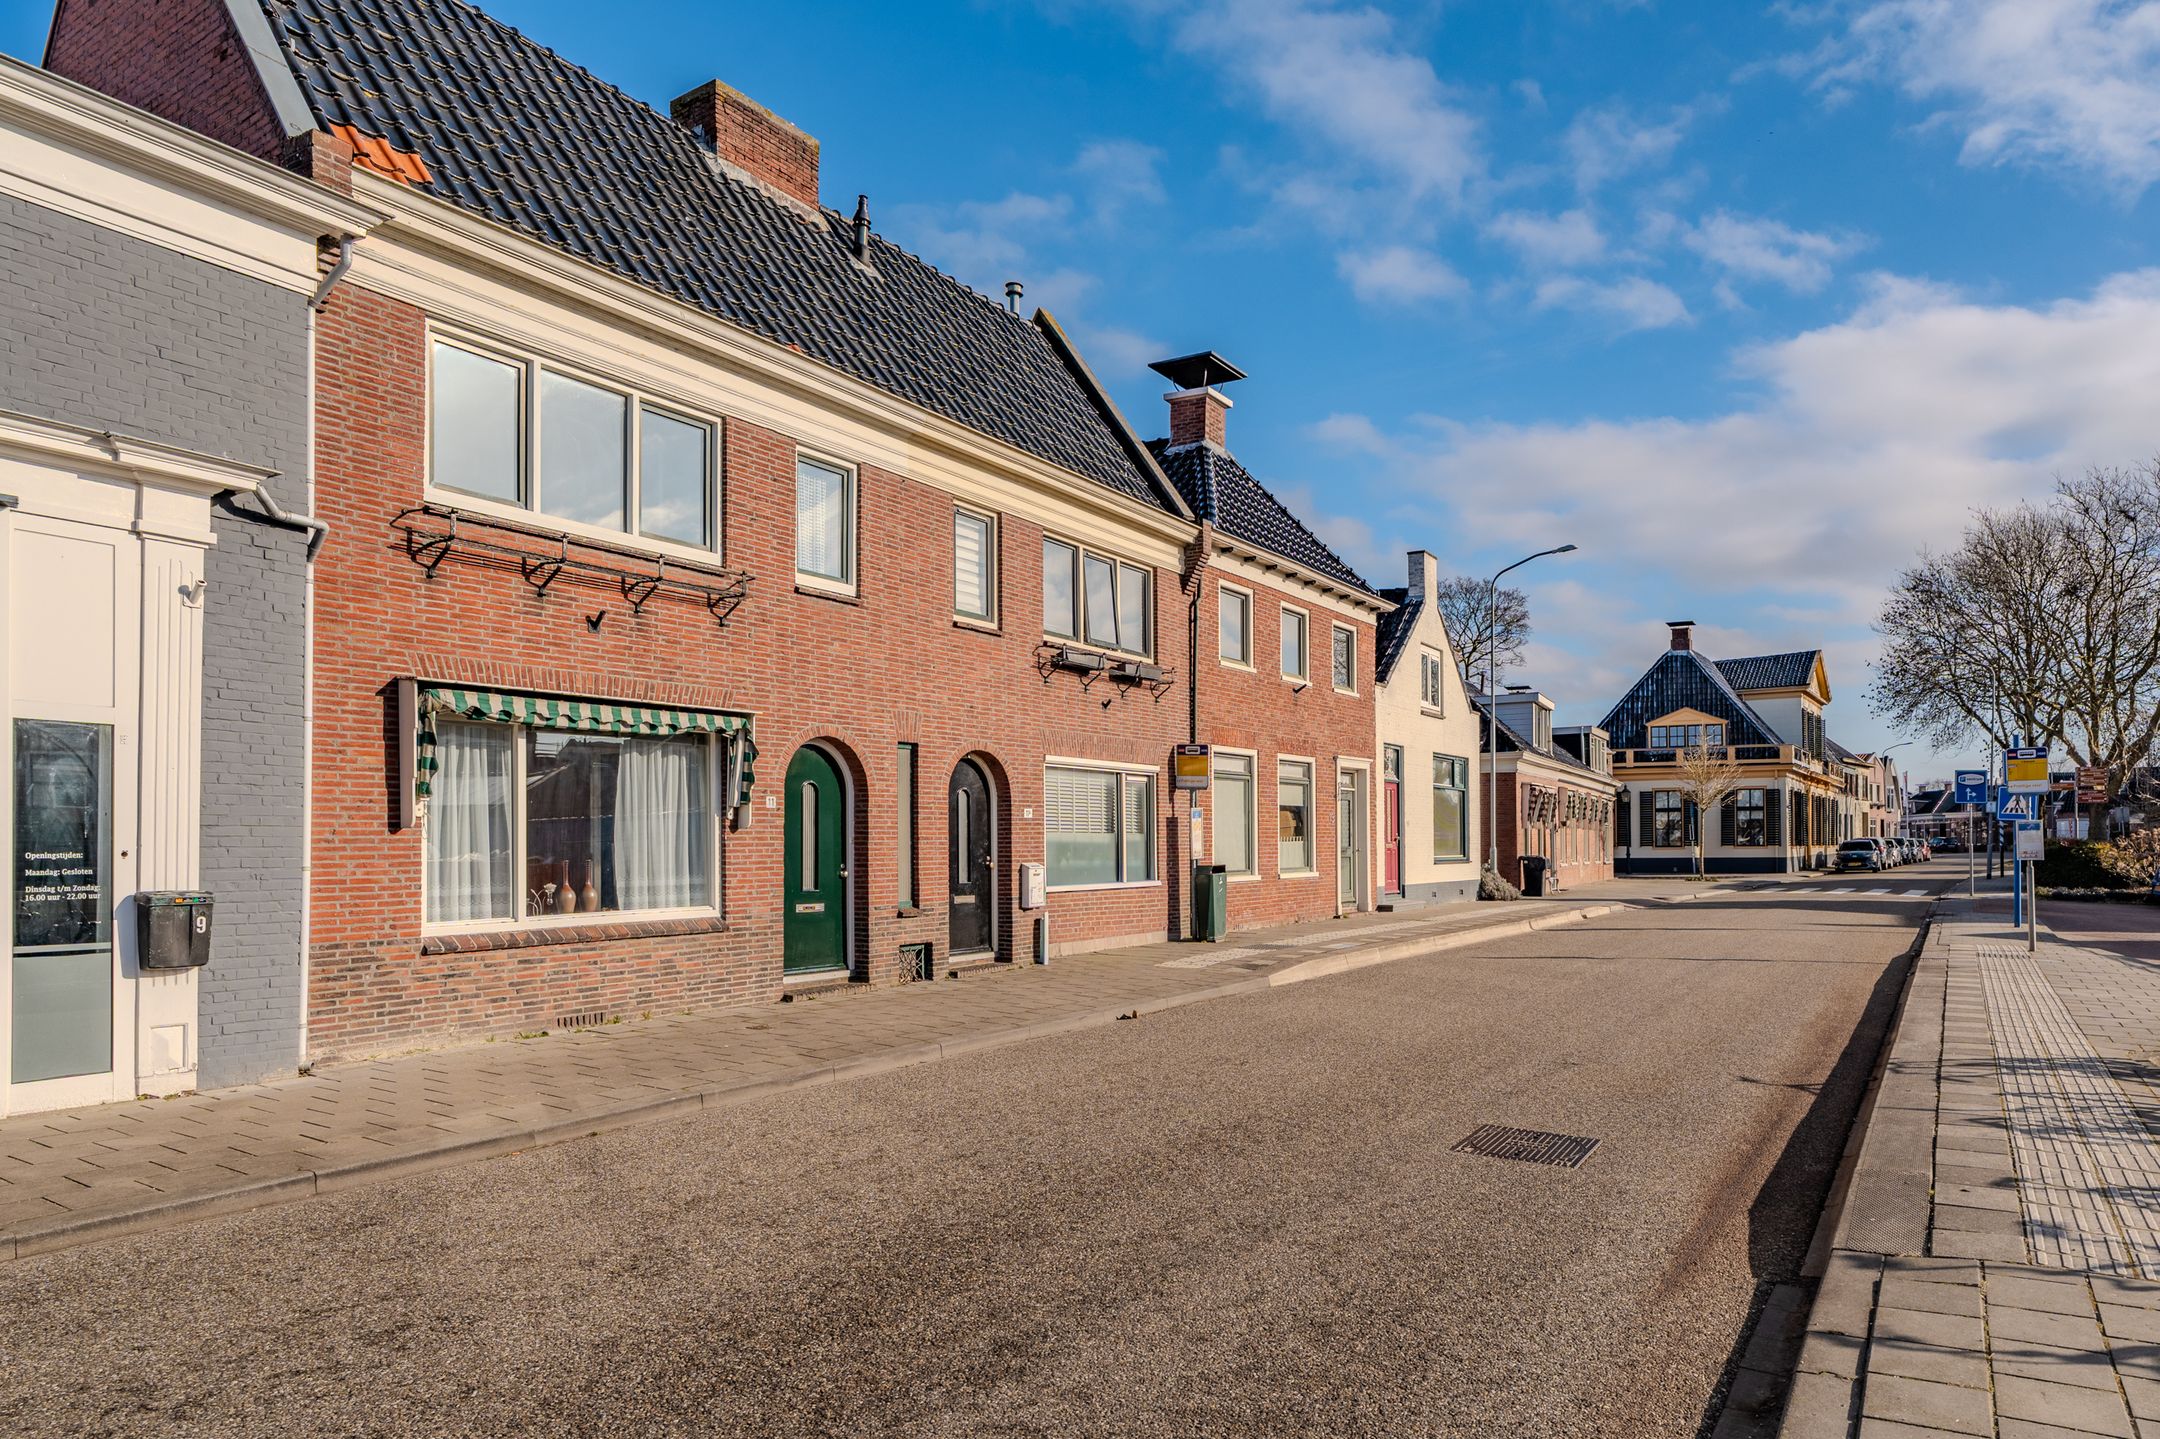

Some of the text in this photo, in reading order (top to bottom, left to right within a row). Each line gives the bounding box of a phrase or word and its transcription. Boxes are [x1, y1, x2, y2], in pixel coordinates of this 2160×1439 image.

[768, 798, 775, 807] 11
[25, 852, 83, 860] Openingstijden:
[72, 884, 101, 892] Zondag:
[25, 894, 46, 902] 16.00
[196, 916, 207, 934] 9
